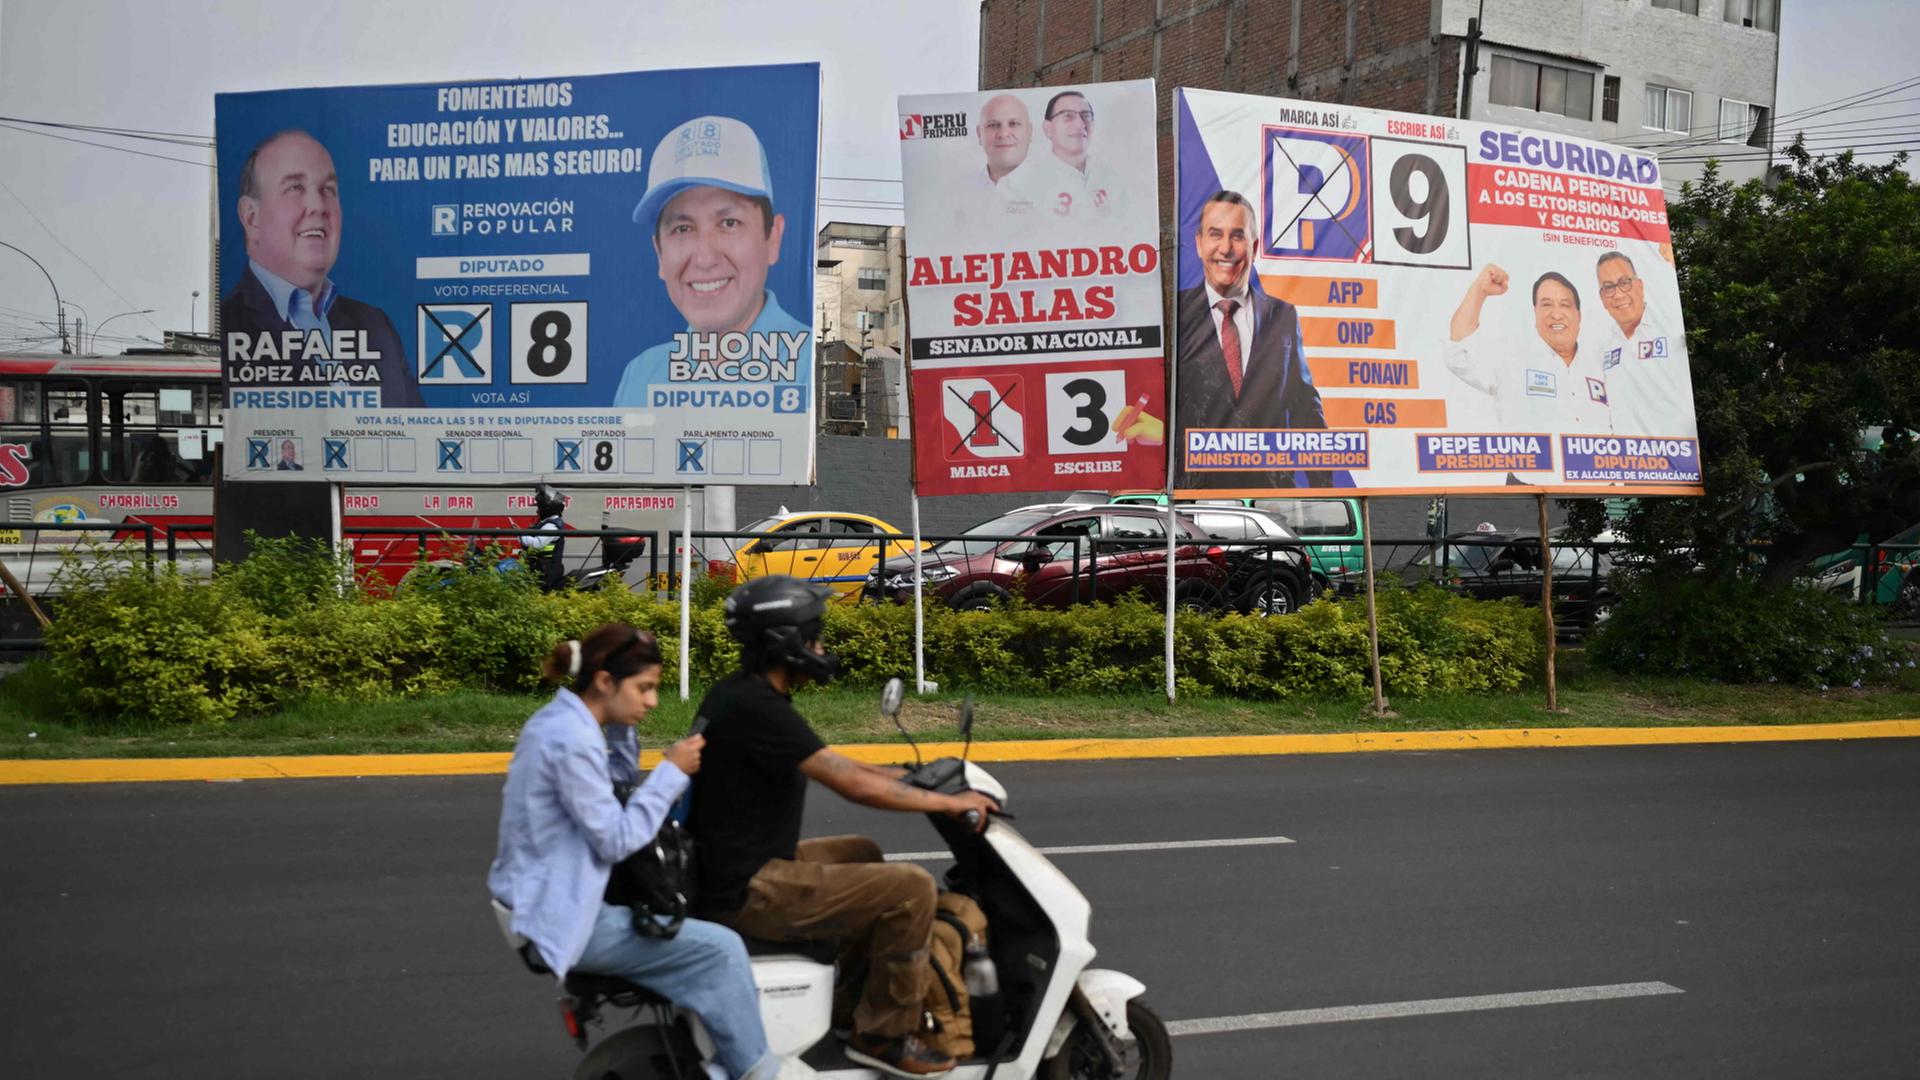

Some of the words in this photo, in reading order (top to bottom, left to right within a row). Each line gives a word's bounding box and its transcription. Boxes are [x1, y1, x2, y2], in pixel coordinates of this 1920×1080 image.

[437, 83, 573, 112] FOMENTEMOS
[1280, 108, 1319, 126] MARCA
[1322, 110, 1339, 128] ASÍ
[387, 116, 499, 147] EDUCACIÓN
[504, 119, 517, 143] Y
[521, 115, 624, 142] VALORES...
[923, 127, 968, 139] PRIMERO
[1387, 120, 1427, 138] ESCRIBE
[1430, 123, 1445, 140] ASÍ
[369, 158, 420, 181] PARA
[424, 156, 450, 180] UN
[455, 154, 500, 179] PAIS
[504, 152, 549, 177] MAS
[553, 148, 642, 175] SEGURO!
[1479, 130, 1658, 185] SEGURIDAD
[1494, 169, 1565, 194] CADENA
[1568, 178, 1649, 207] PERPETUA
[463, 197, 574, 218] RENOVACIÓN
[1053, 192, 1072, 216] 3
[1389, 153, 1450, 254] 9
[1479, 189, 1491, 204] A
[1495, 190, 1525, 207] LOS
[1529, 193, 1667, 225] EXTORSIONADORES
[434, 207, 457, 232] R
[463, 218, 574, 235] POPULAR
[1537, 211, 1547, 225] Y
[1551, 214, 1620, 234] SICARIOS
[1542, 232, 1560, 243] (SIN
[1563, 234, 1618, 250] BENEFICIOS)
[459, 259, 544, 273] DIPUTADO
[909, 243, 1158, 289] ALEJANDRO
[434, 285, 469, 297] VOTO
[472, 283, 569, 296] PREFERENCIAL
[1328, 281, 1363, 304] AFP
[953, 285, 1115, 327] SALAS
[526, 310, 573, 377] 8
[929, 334, 1028, 355] SENADOR
[1032, 330, 1142, 351] NACIONAL
[1337, 321, 1374, 344] ONP
[227, 330, 381, 361] RAFAEL
[424, 310, 485, 379] R
[669, 331, 809, 361] JHONY
[1655, 340, 1663, 355] 9
[228, 362, 293, 383] LÓPEZ
[299, 364, 381, 382] ALIAGA
[669, 360, 796, 382] BACON
[1349, 362, 1409, 385] FONAVI
[233, 391, 377, 408] PRESIDENTE
[472, 392, 505, 404] VOTA
[509, 390, 530, 403] ASÍ
[653, 391, 770, 407] DIPUTADO
[779, 387, 800, 411] 8
[355, 416, 382, 425] VOTA
[407, 417, 443, 425] MARCA
[446, 417, 466, 425] LAS
[469, 417, 475, 425] 5
[478, 417, 485, 425] R
[488, 417, 495, 425] Y
[498, 417, 511, 425] EN
[515, 416, 574, 425] DIPUTADOS
[578, 416, 622, 425] ESCRIBE
[967, 390, 999, 447] 1
[1062, 378, 1109, 446] 3
[1364, 402, 1397, 425] CAS
[253, 429, 295, 437] PRESIDENTE
[483, 430, 522, 438] REGIONAL
[683, 430, 739, 438] PARLAMENTO
[741, 430, 775, 438] ANDINO
[1189, 432, 1270, 451] DANIEL
[1276, 432, 1366, 451] URRESTI
[247, 440, 270, 468] R
[324, 440, 348, 468] R
[438, 441, 463, 470] R
[556, 441, 581, 470] R
[594, 440, 613, 471] 8
[679, 441, 704, 471] R
[1428, 437, 1480, 454] PEPE
[1486, 437, 1541, 454] LUNA
[1567, 438, 1621, 455] HUGO
[1626, 440, 1692, 457] RAMOS
[1054, 461, 1122, 475] ESCRIBE
[1189, 453, 1262, 465] MINISTRO
[1266, 453, 1294, 465] DEL
[1298, 453, 1366, 465] INTERIOR
[1435, 455, 1536, 469] PRESIDENTE
[1594, 455, 1669, 470] DIPUTADO
[950, 465, 1010, 479] MARCA
[1566, 470, 1580, 479] EX
[1582, 471, 1621, 480] ALCALDE
[1623, 471, 1636, 480] DE
[1638, 470, 1699, 481] PACHACÁMAC
[424, 495, 440, 509] LA
[447, 495, 474, 509] MAR
[605, 495, 675, 510] PACASMAYO
